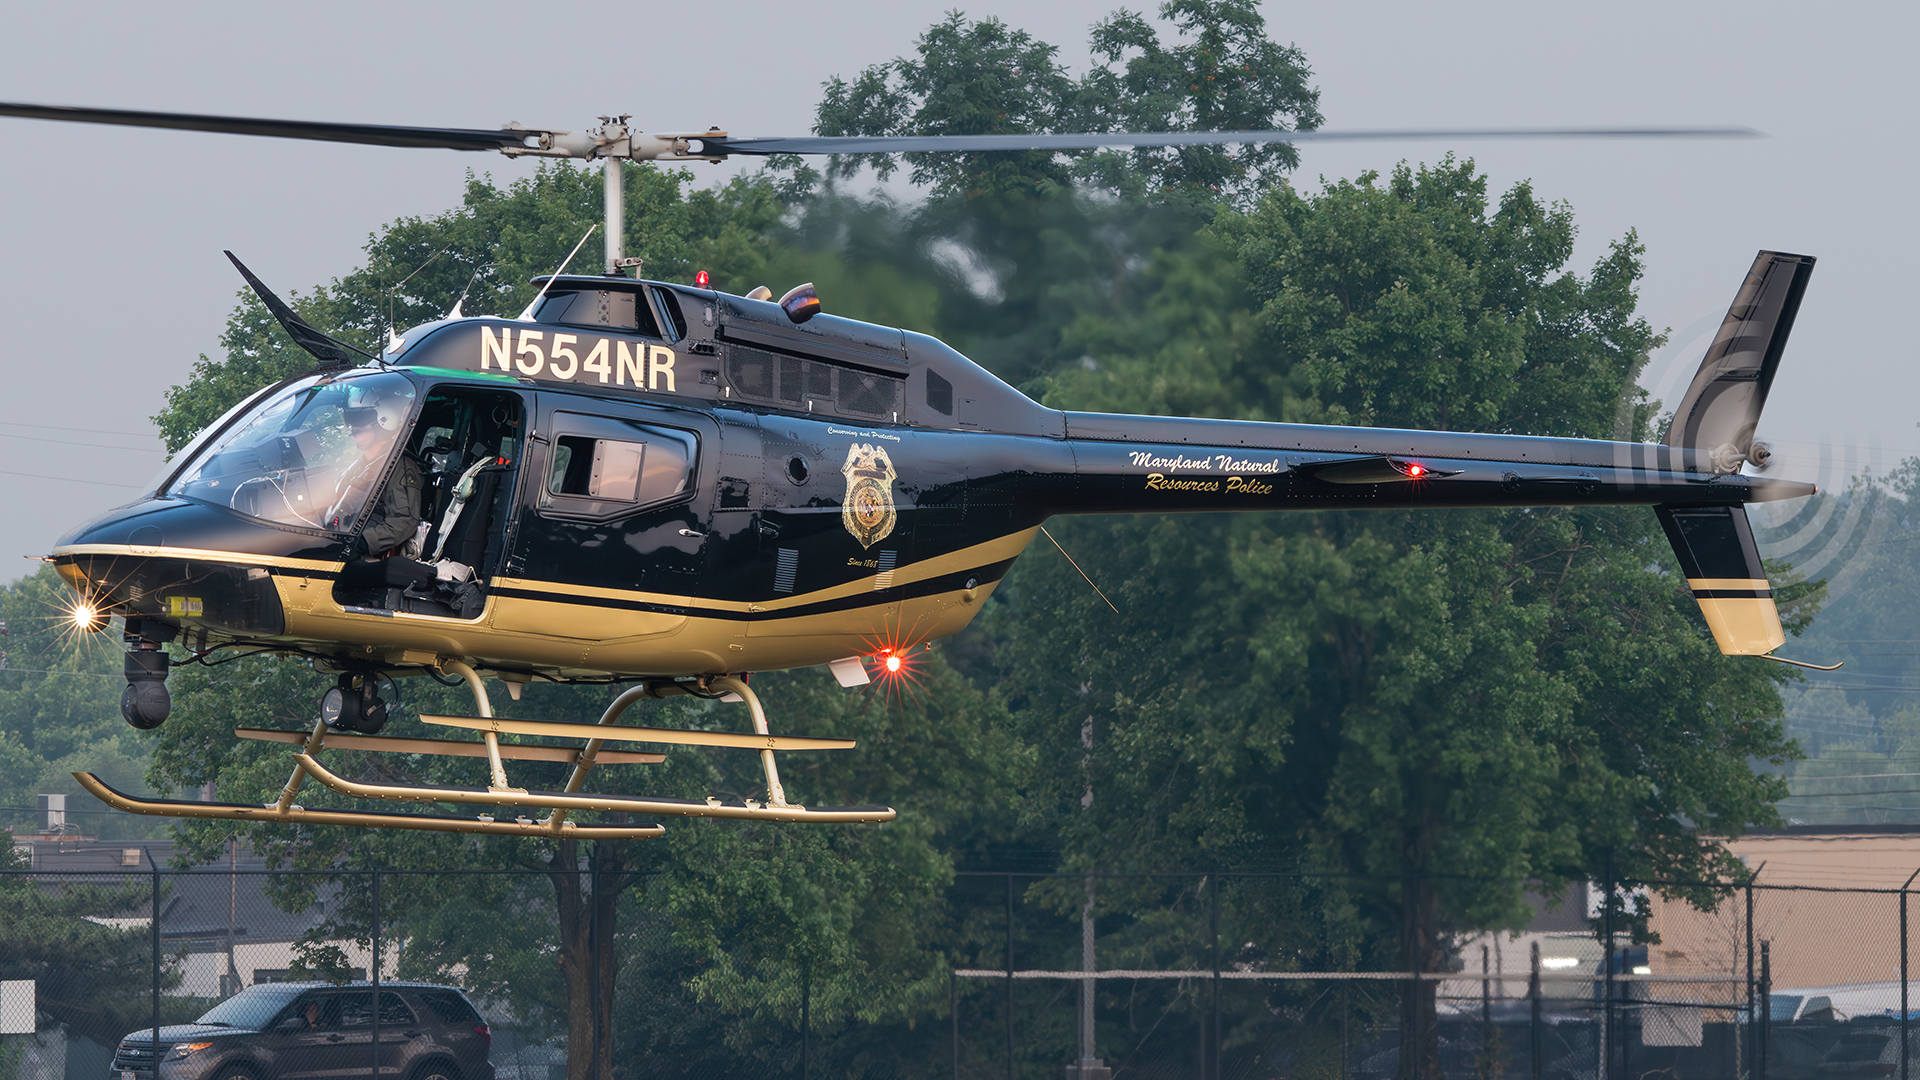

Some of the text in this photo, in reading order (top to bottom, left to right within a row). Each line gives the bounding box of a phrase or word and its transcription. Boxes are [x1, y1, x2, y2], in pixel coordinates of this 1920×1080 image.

[481, 325, 677, 392] N554NR
[827, 426, 858, 438] Conserving
[871, 431, 901, 443] Protecting
[1129, 451, 1280, 473] Maryland Natural
[1144, 472, 1273, 495] Resources Police
[846, 557, 863, 567] Since
